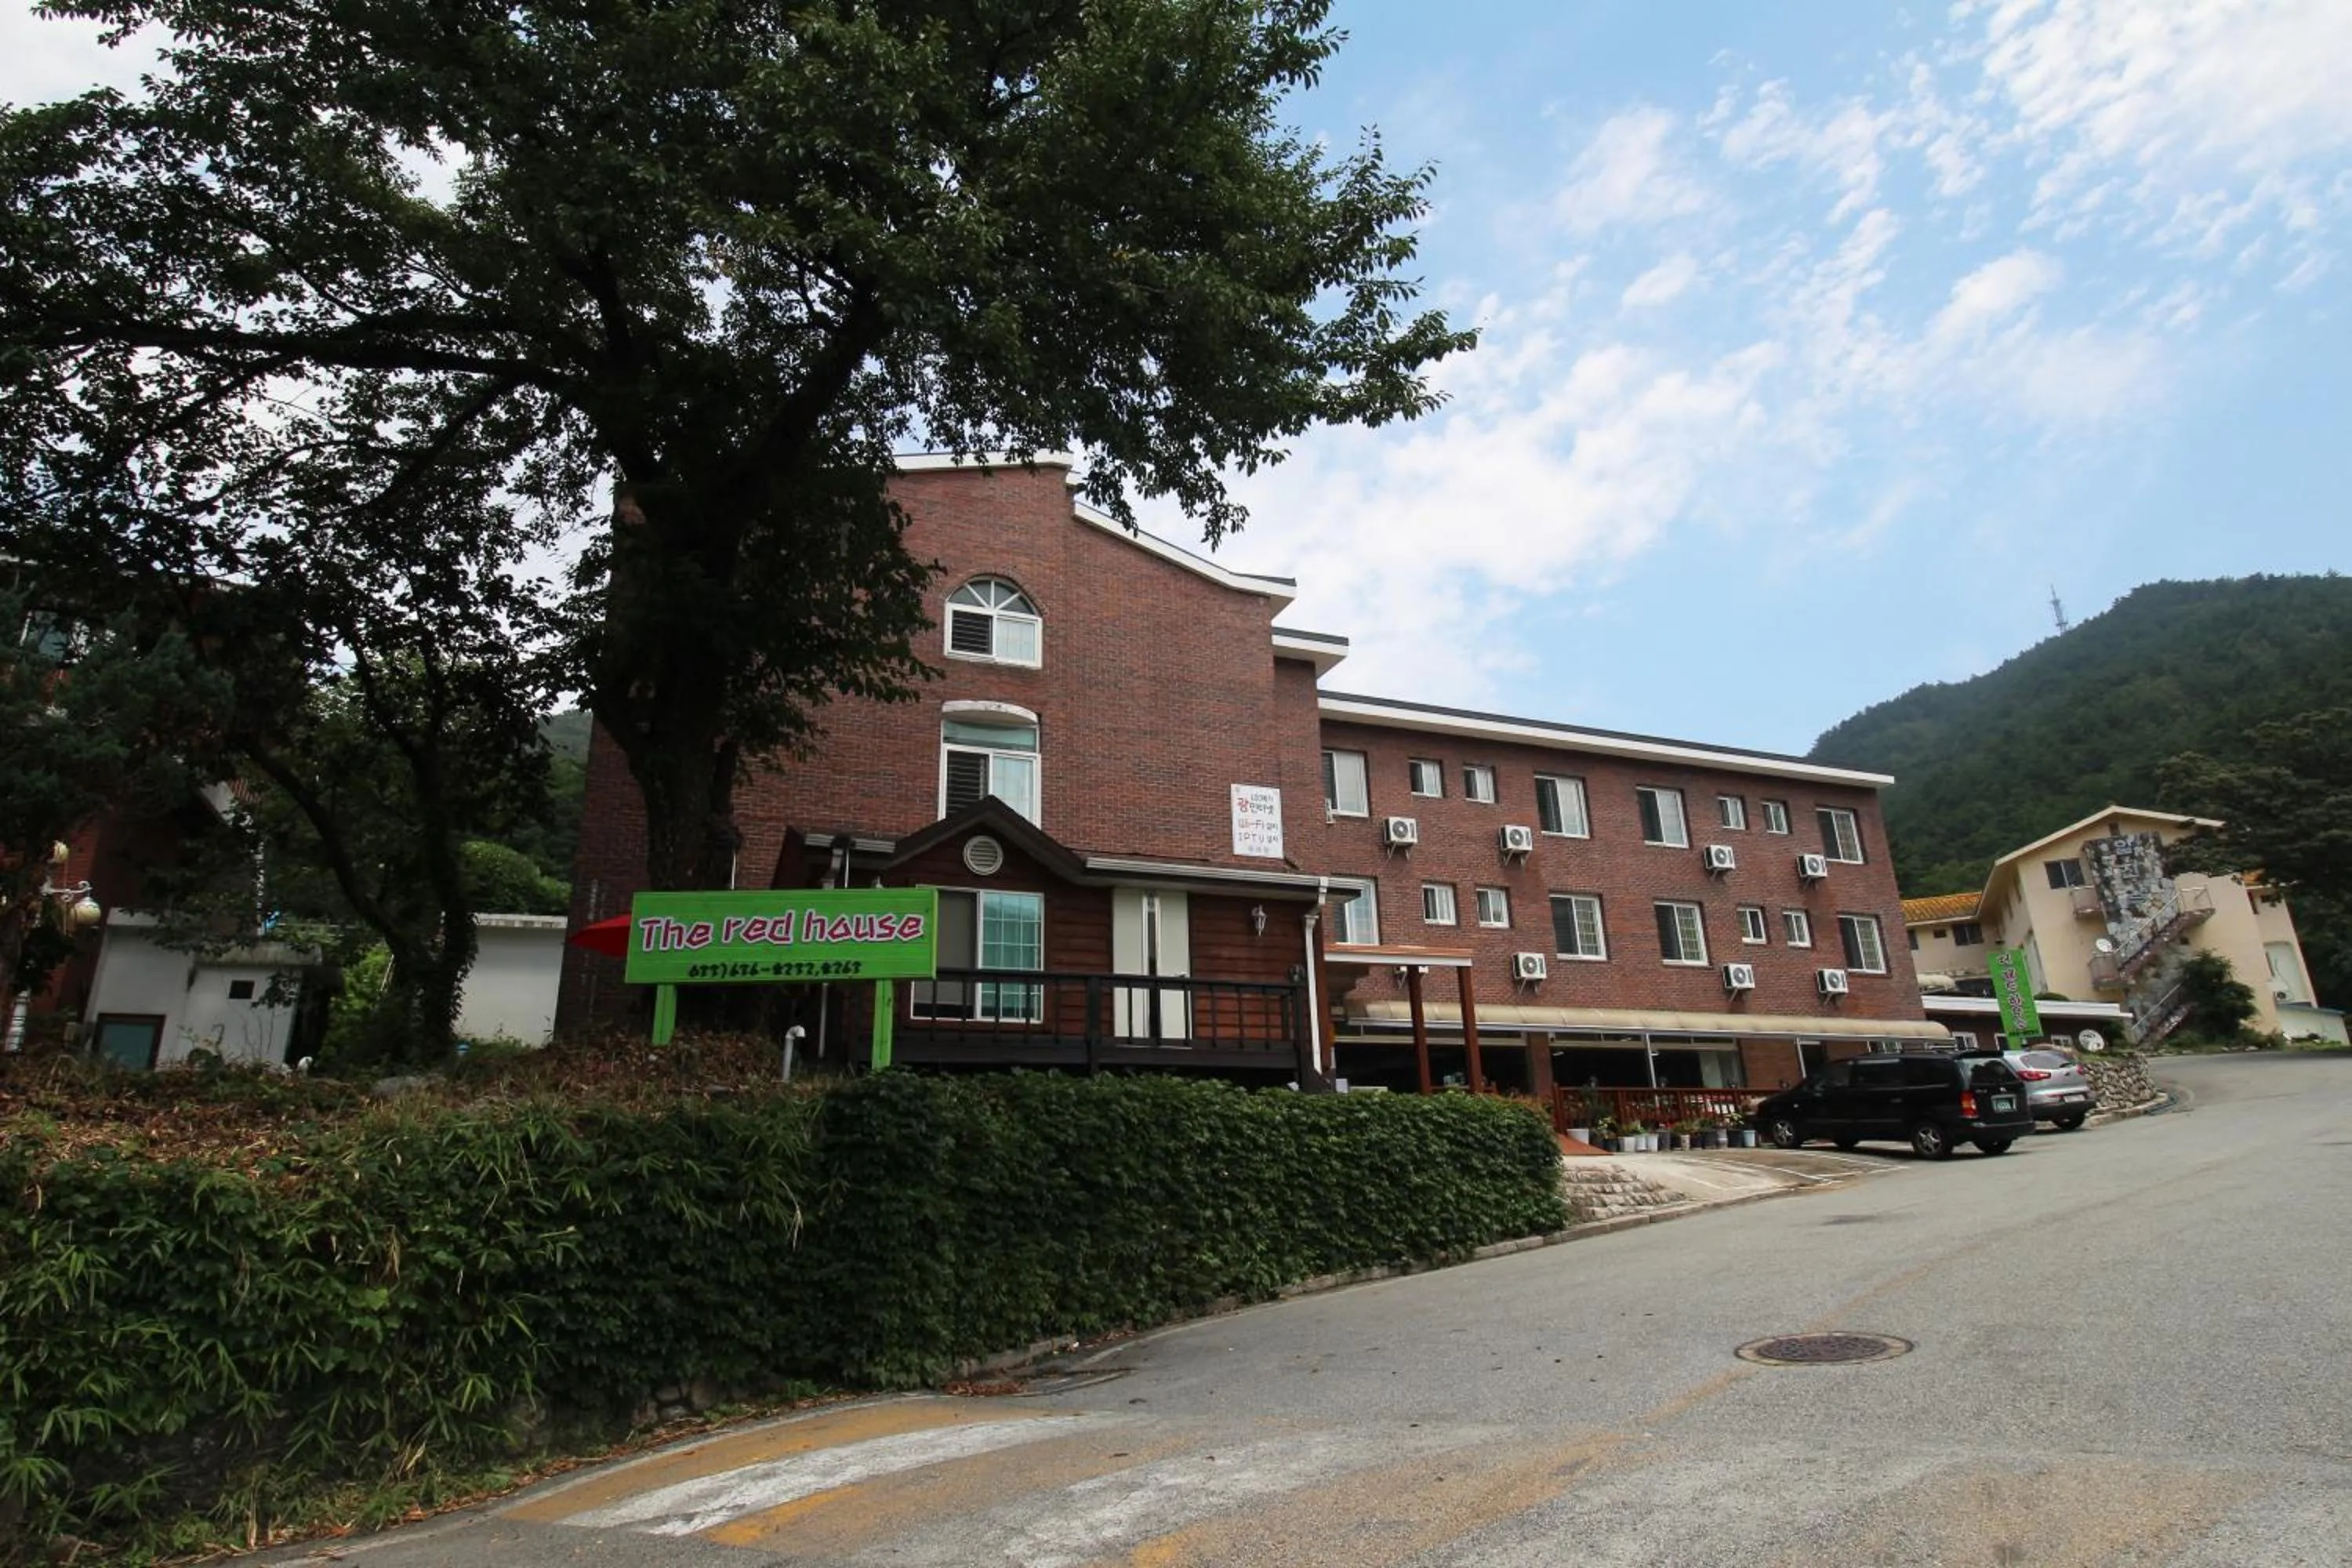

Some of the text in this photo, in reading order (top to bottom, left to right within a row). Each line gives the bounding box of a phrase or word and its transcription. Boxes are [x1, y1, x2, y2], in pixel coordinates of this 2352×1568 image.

[639, 909, 925, 952] The red house
